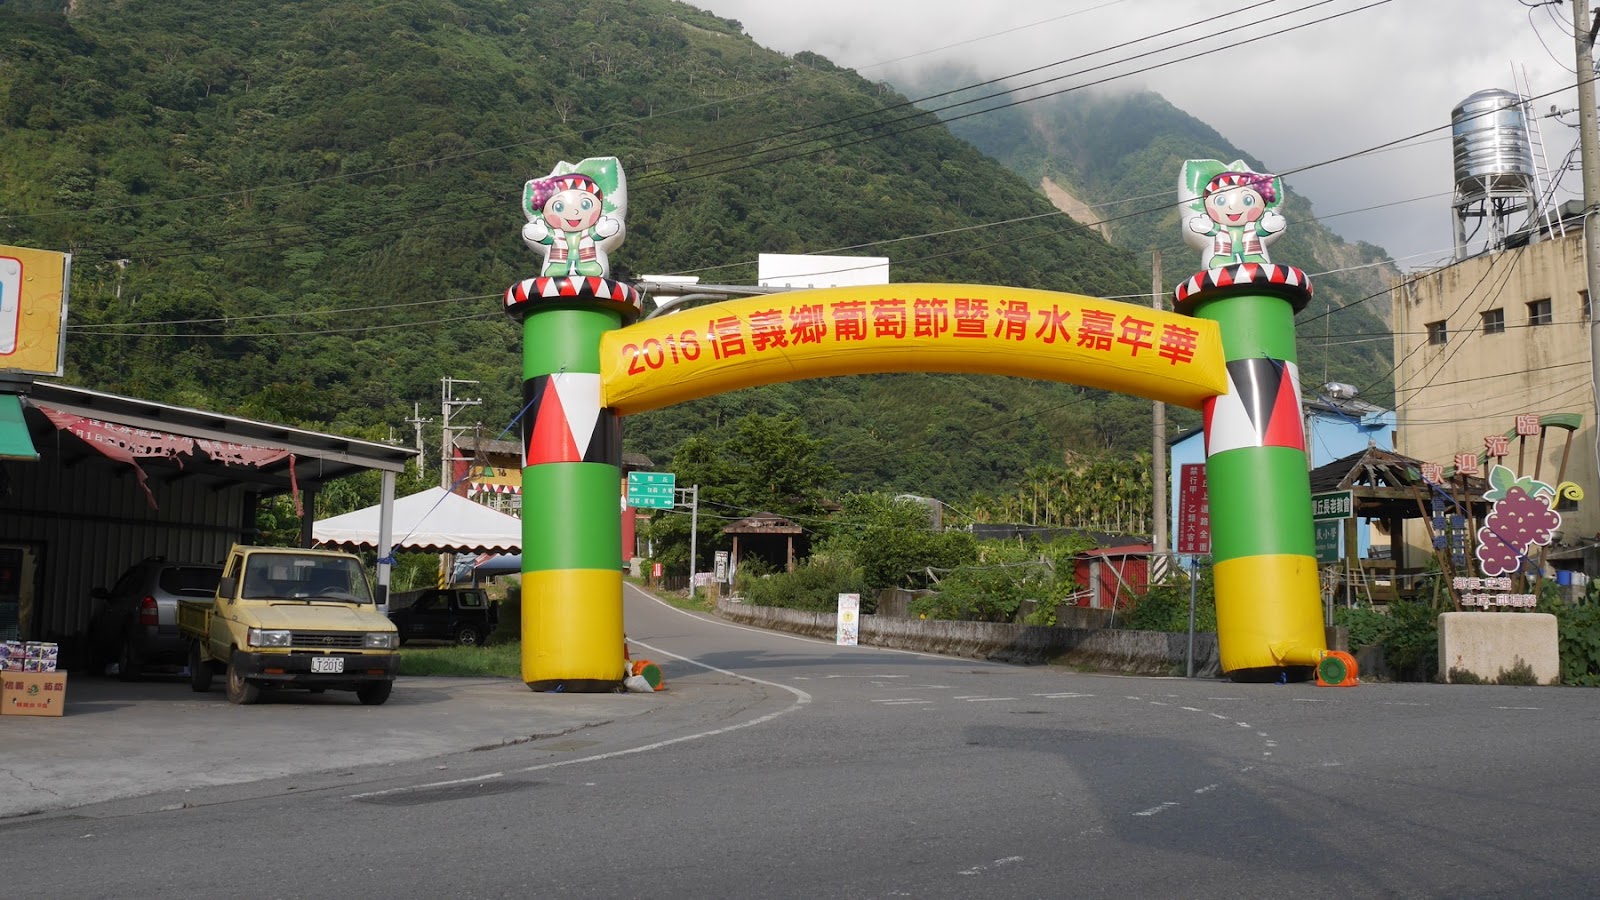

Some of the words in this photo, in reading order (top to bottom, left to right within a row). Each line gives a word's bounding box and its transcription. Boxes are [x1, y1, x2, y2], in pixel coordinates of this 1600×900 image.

[621, 329, 701, 376] 2016
[707, 298, 1200, 366] 信義鄉葡萄節暨滑水嘉年華
